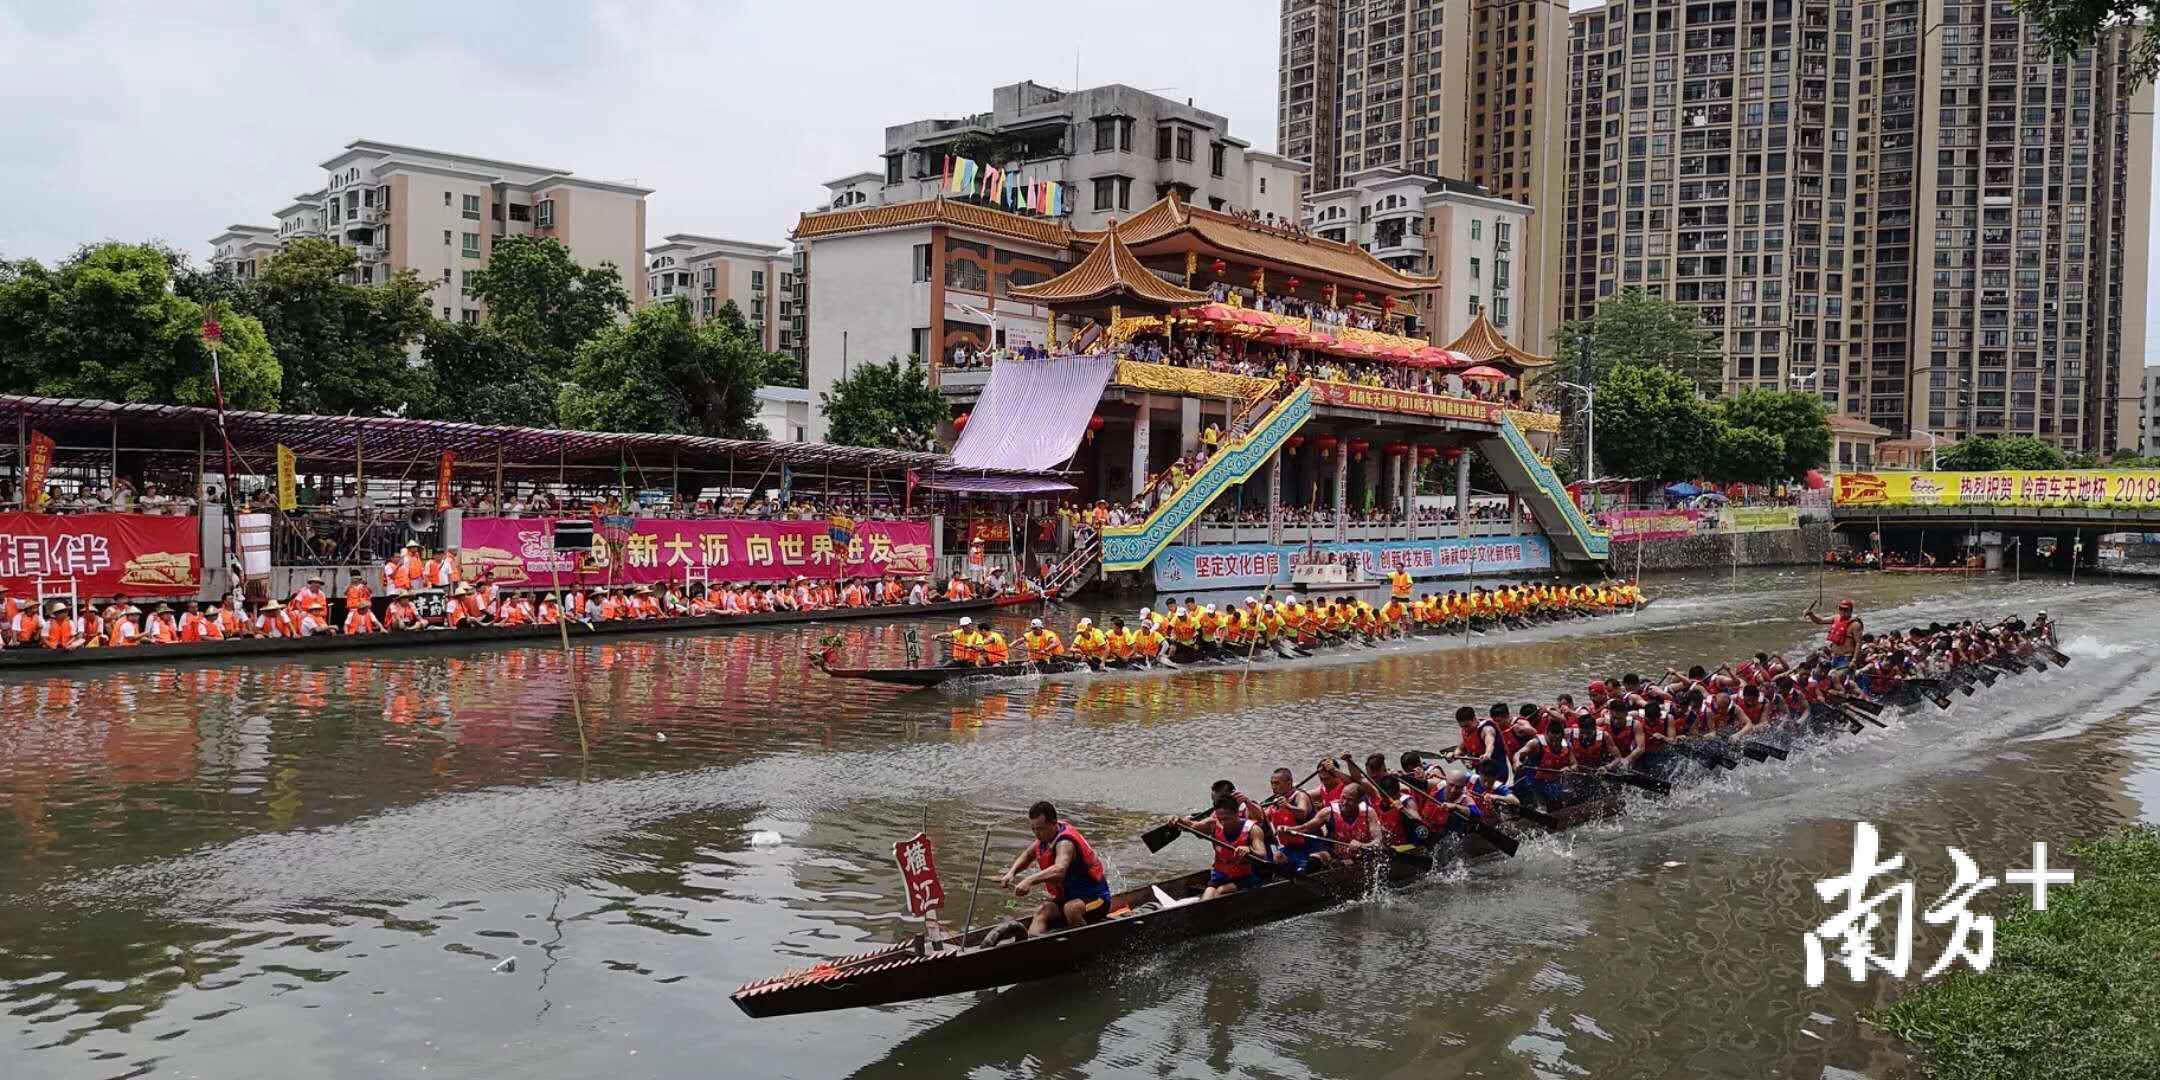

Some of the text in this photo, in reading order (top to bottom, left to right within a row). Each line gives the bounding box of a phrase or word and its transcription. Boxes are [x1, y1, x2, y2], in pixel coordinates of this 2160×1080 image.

[1961, 476, 2160, 502] 热烈祝贺 岭南车天地杯 2018
[0, 534, 110, 577] 相伴
[746, 533, 892, 566] 向世界进发
[1195, 553, 1279, 578] 坚定文化自信
[1380, 548, 1434, 570] 创新性发展
[1440, 543, 1522, 565] 铸就中华文化新辉煌
[903, 841, 940, 912] 横江
